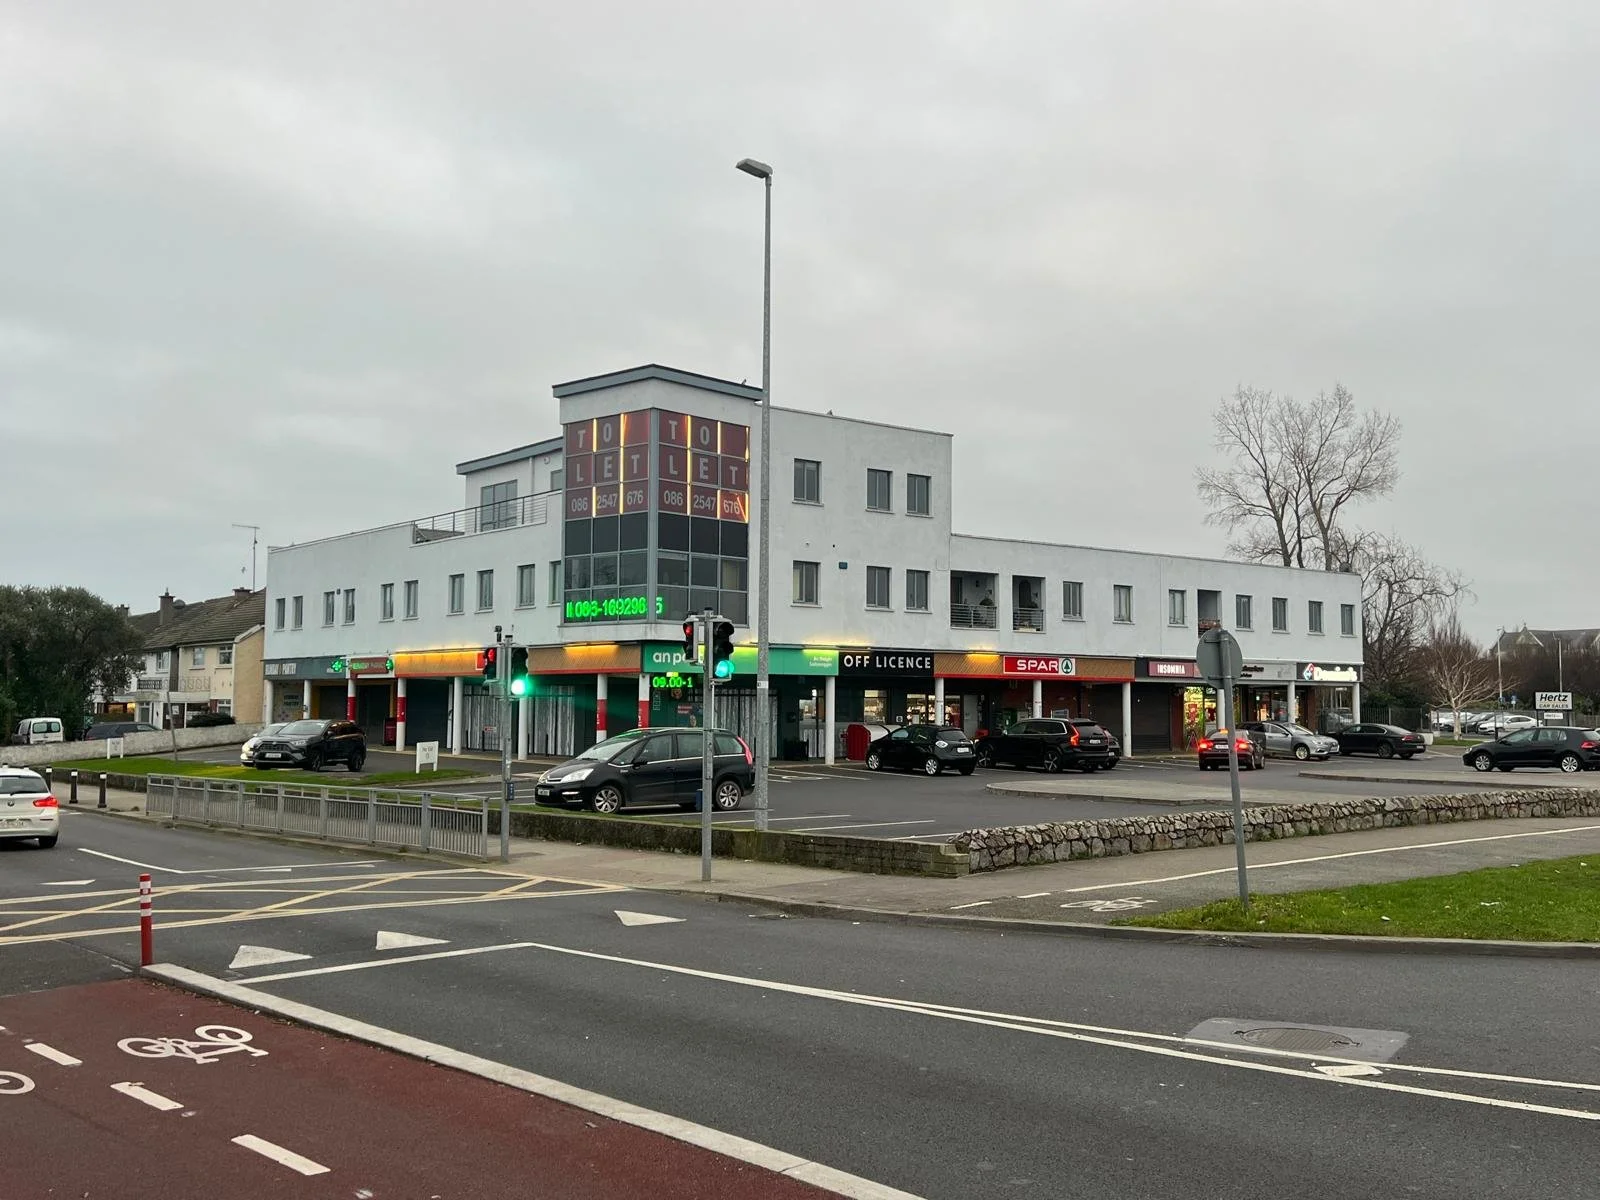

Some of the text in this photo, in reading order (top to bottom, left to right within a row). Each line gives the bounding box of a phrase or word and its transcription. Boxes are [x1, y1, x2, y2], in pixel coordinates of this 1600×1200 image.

[571, 490, 643, 512] 086 2547 676
[664, 490, 740, 515] 086 2547 676
[652, 652, 671, 663] an
[844, 655, 870, 668] OFF
[876, 656, 931, 669] LICENCE
[1016, 659, 1059, 671] SPAR
[1157, 663, 1186, 675] INSOMNIA
[1539, 693, 1568, 702] Hertz
